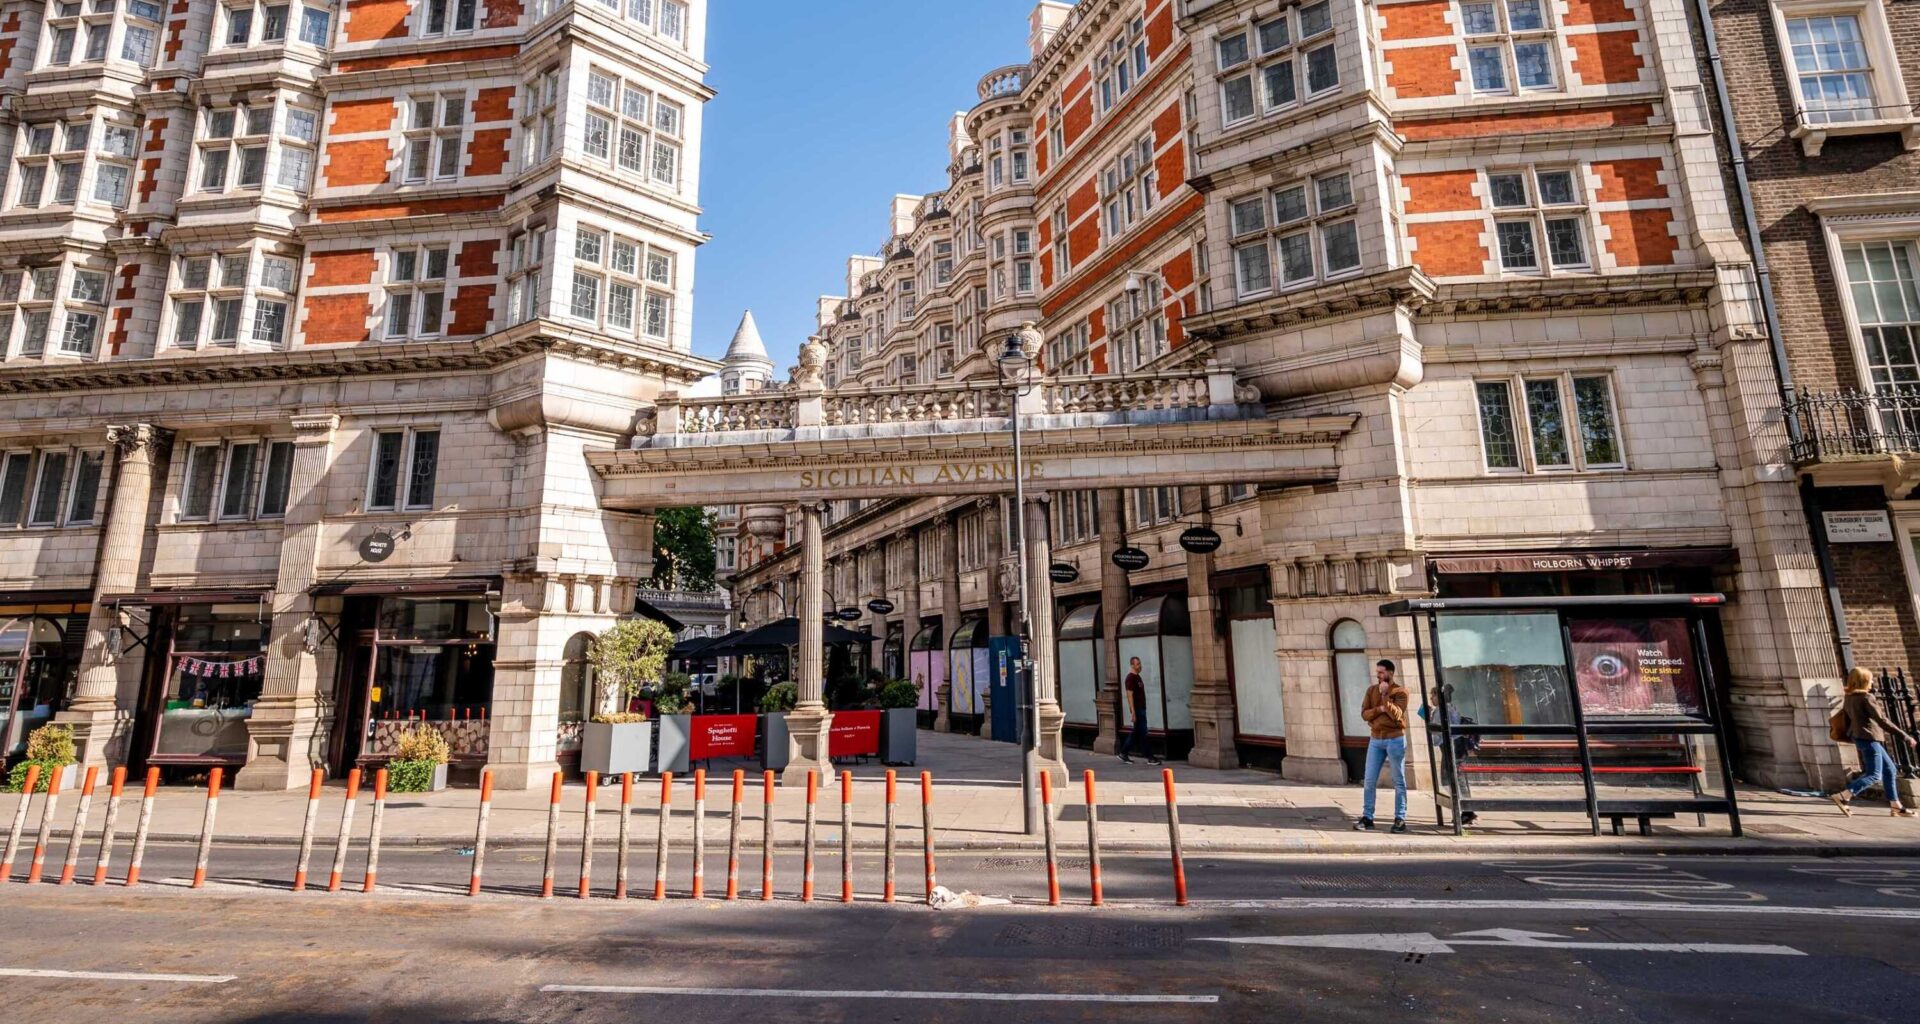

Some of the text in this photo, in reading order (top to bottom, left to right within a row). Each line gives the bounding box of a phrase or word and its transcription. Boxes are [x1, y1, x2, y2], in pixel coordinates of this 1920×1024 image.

[800, 461, 1045, 489] SICILIAN AVENUE
[1533, 556, 1633, 569] HOLBORN WHIPPET
[1636, 648, 1663, 657] Watch
[1638, 657, 1685, 666] your speed.
[1640, 667, 1682, 675] Your sister
[1641, 674, 1663, 683] does.
[707, 727, 738, 735] Spaghetti
